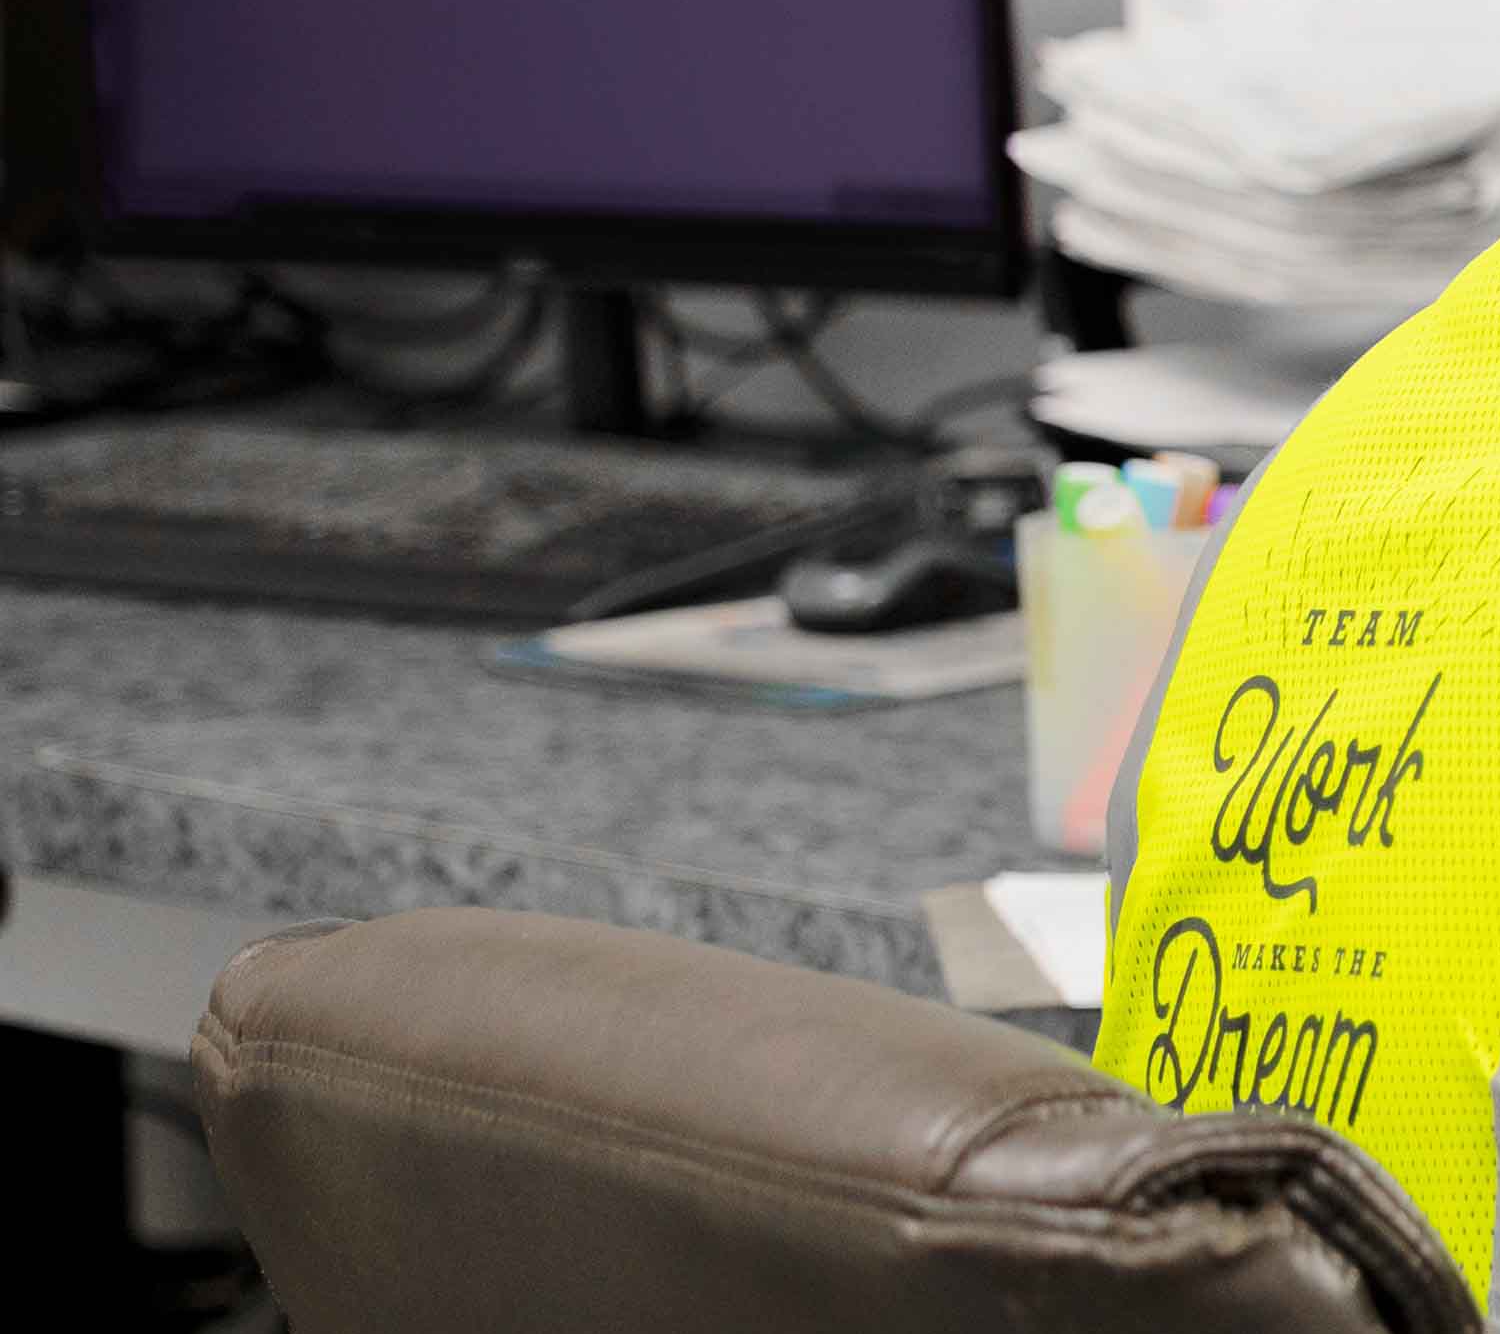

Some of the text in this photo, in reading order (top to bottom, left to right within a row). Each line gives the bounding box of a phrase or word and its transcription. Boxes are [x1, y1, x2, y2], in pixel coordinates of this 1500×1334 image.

[1301, 609, 1424, 647] TEAM
[1210, 670, 1443, 915] Work
[1146, 916, 1379, 1126] Dream
[1231, 943, 1388, 979] MAKES THE
